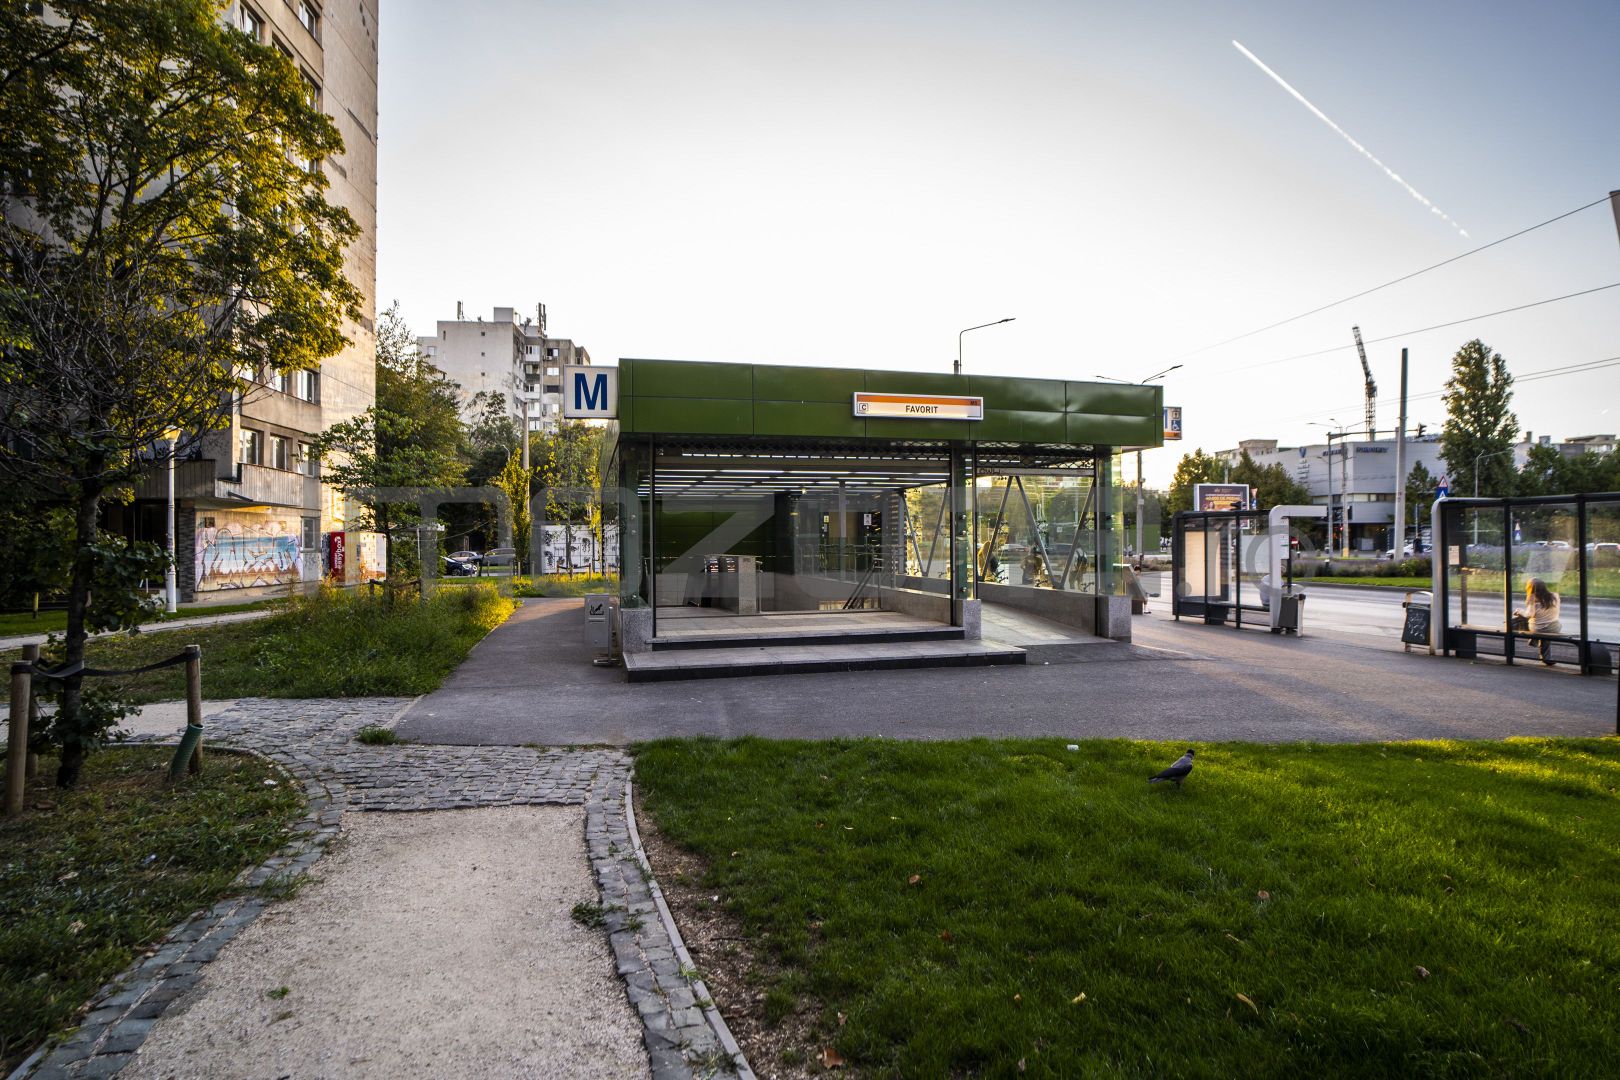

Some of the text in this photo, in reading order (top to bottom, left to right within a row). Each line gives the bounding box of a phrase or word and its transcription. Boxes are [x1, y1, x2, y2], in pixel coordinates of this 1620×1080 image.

[574, 372, 608, 410] M
[905, 405, 939, 413] FAVORIT
[336, 539, 344, 570] easybox
